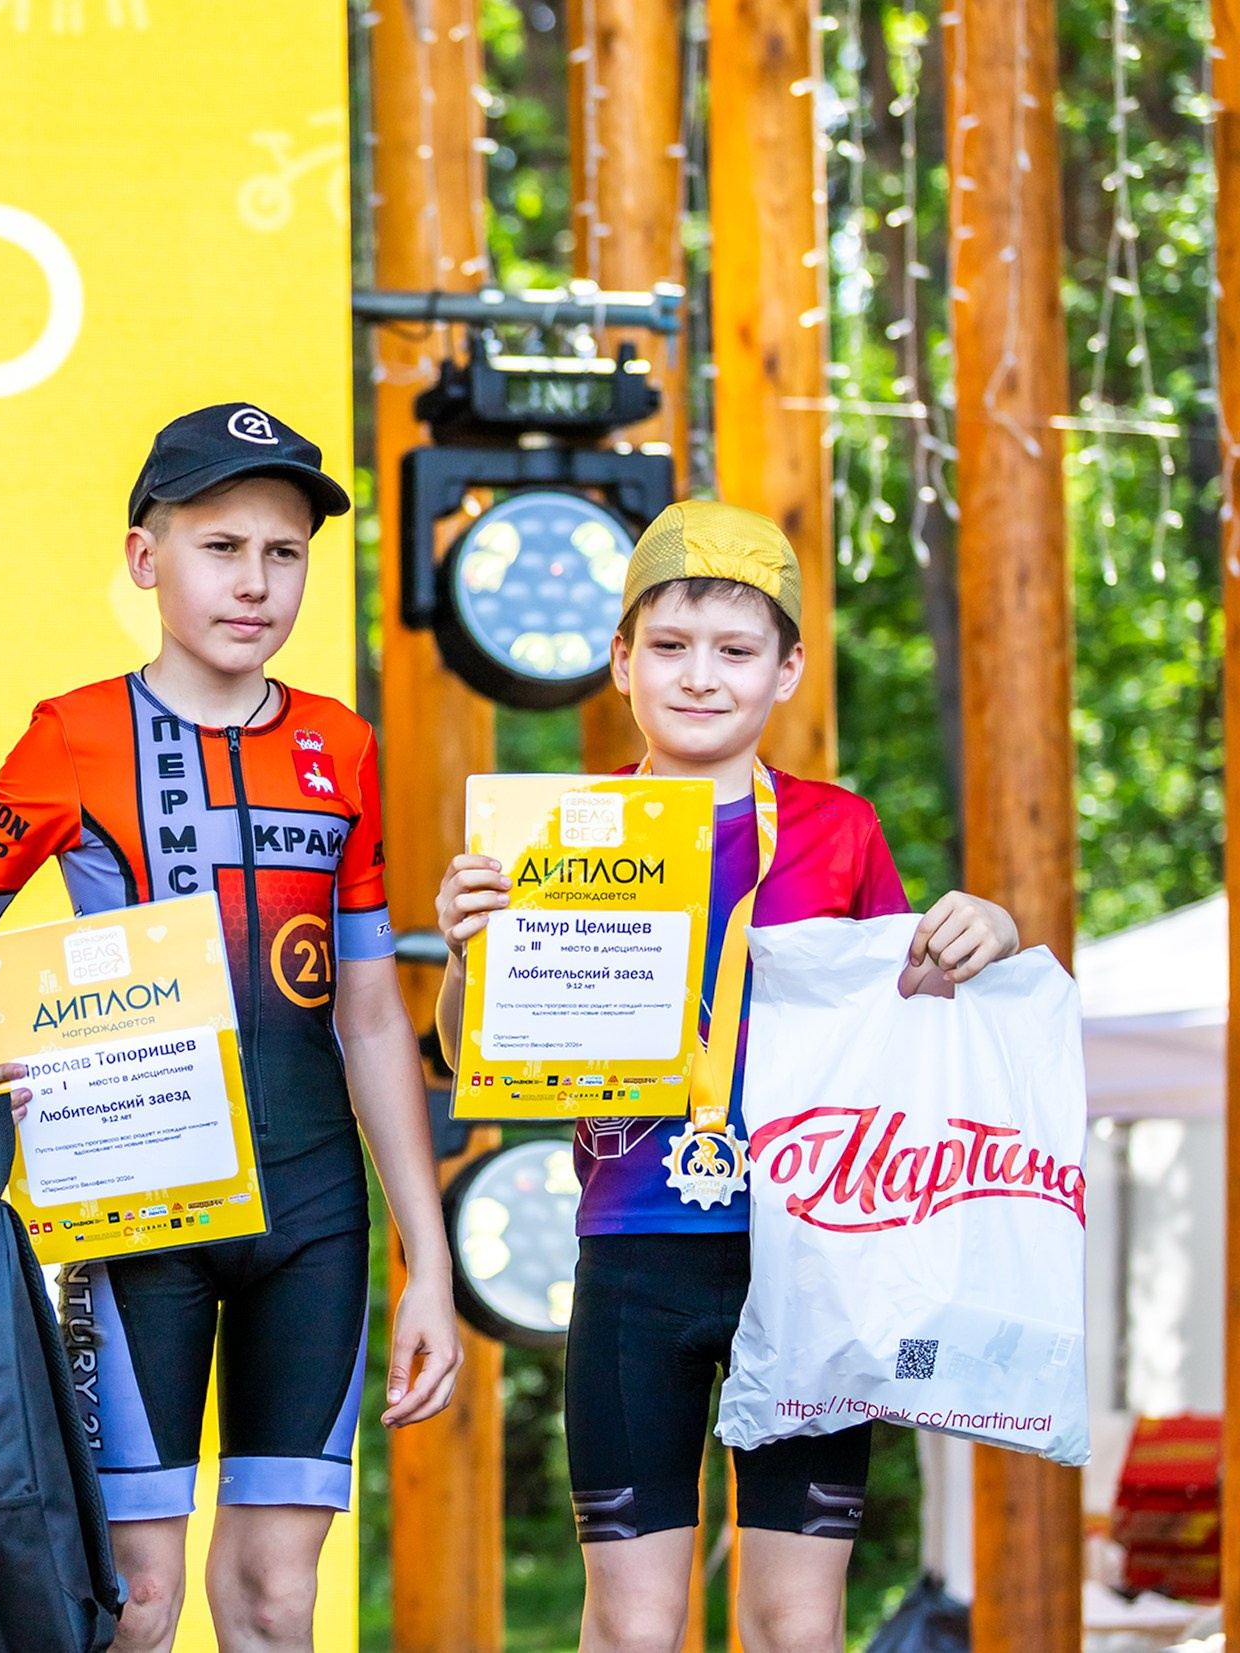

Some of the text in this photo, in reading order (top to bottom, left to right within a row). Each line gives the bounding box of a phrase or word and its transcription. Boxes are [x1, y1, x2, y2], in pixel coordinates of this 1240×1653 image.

[253, 824, 344, 858] КРАЙ
[517, 857, 664, 887] ДИПЛОМ
[544, 891, 636, 902] награждается
[516, 918, 652, 936] Тимур Целищев
[531, 941, 541, 951] III
[560, 945, 591, 953] место
[601, 945, 662, 954] дисциплине
[508, 966, 654, 981] Любительский заезд
[33, 978, 180, 1032] ДИПЛОМ
[62, 1015, 155, 1040] награждается
[95, 1039, 196, 1065] Топорищев
[40, 1087, 53, 1096] за
[88, 1076, 120, 1088] место
[130, 1064, 194, 1082] дисциплине
[39, 1090, 191, 1123] Любительский заезд
[101, 1113, 132, 1124] 9-12 лет
[775, 1396, 1052, 1432] https://taplikcc/martinural
